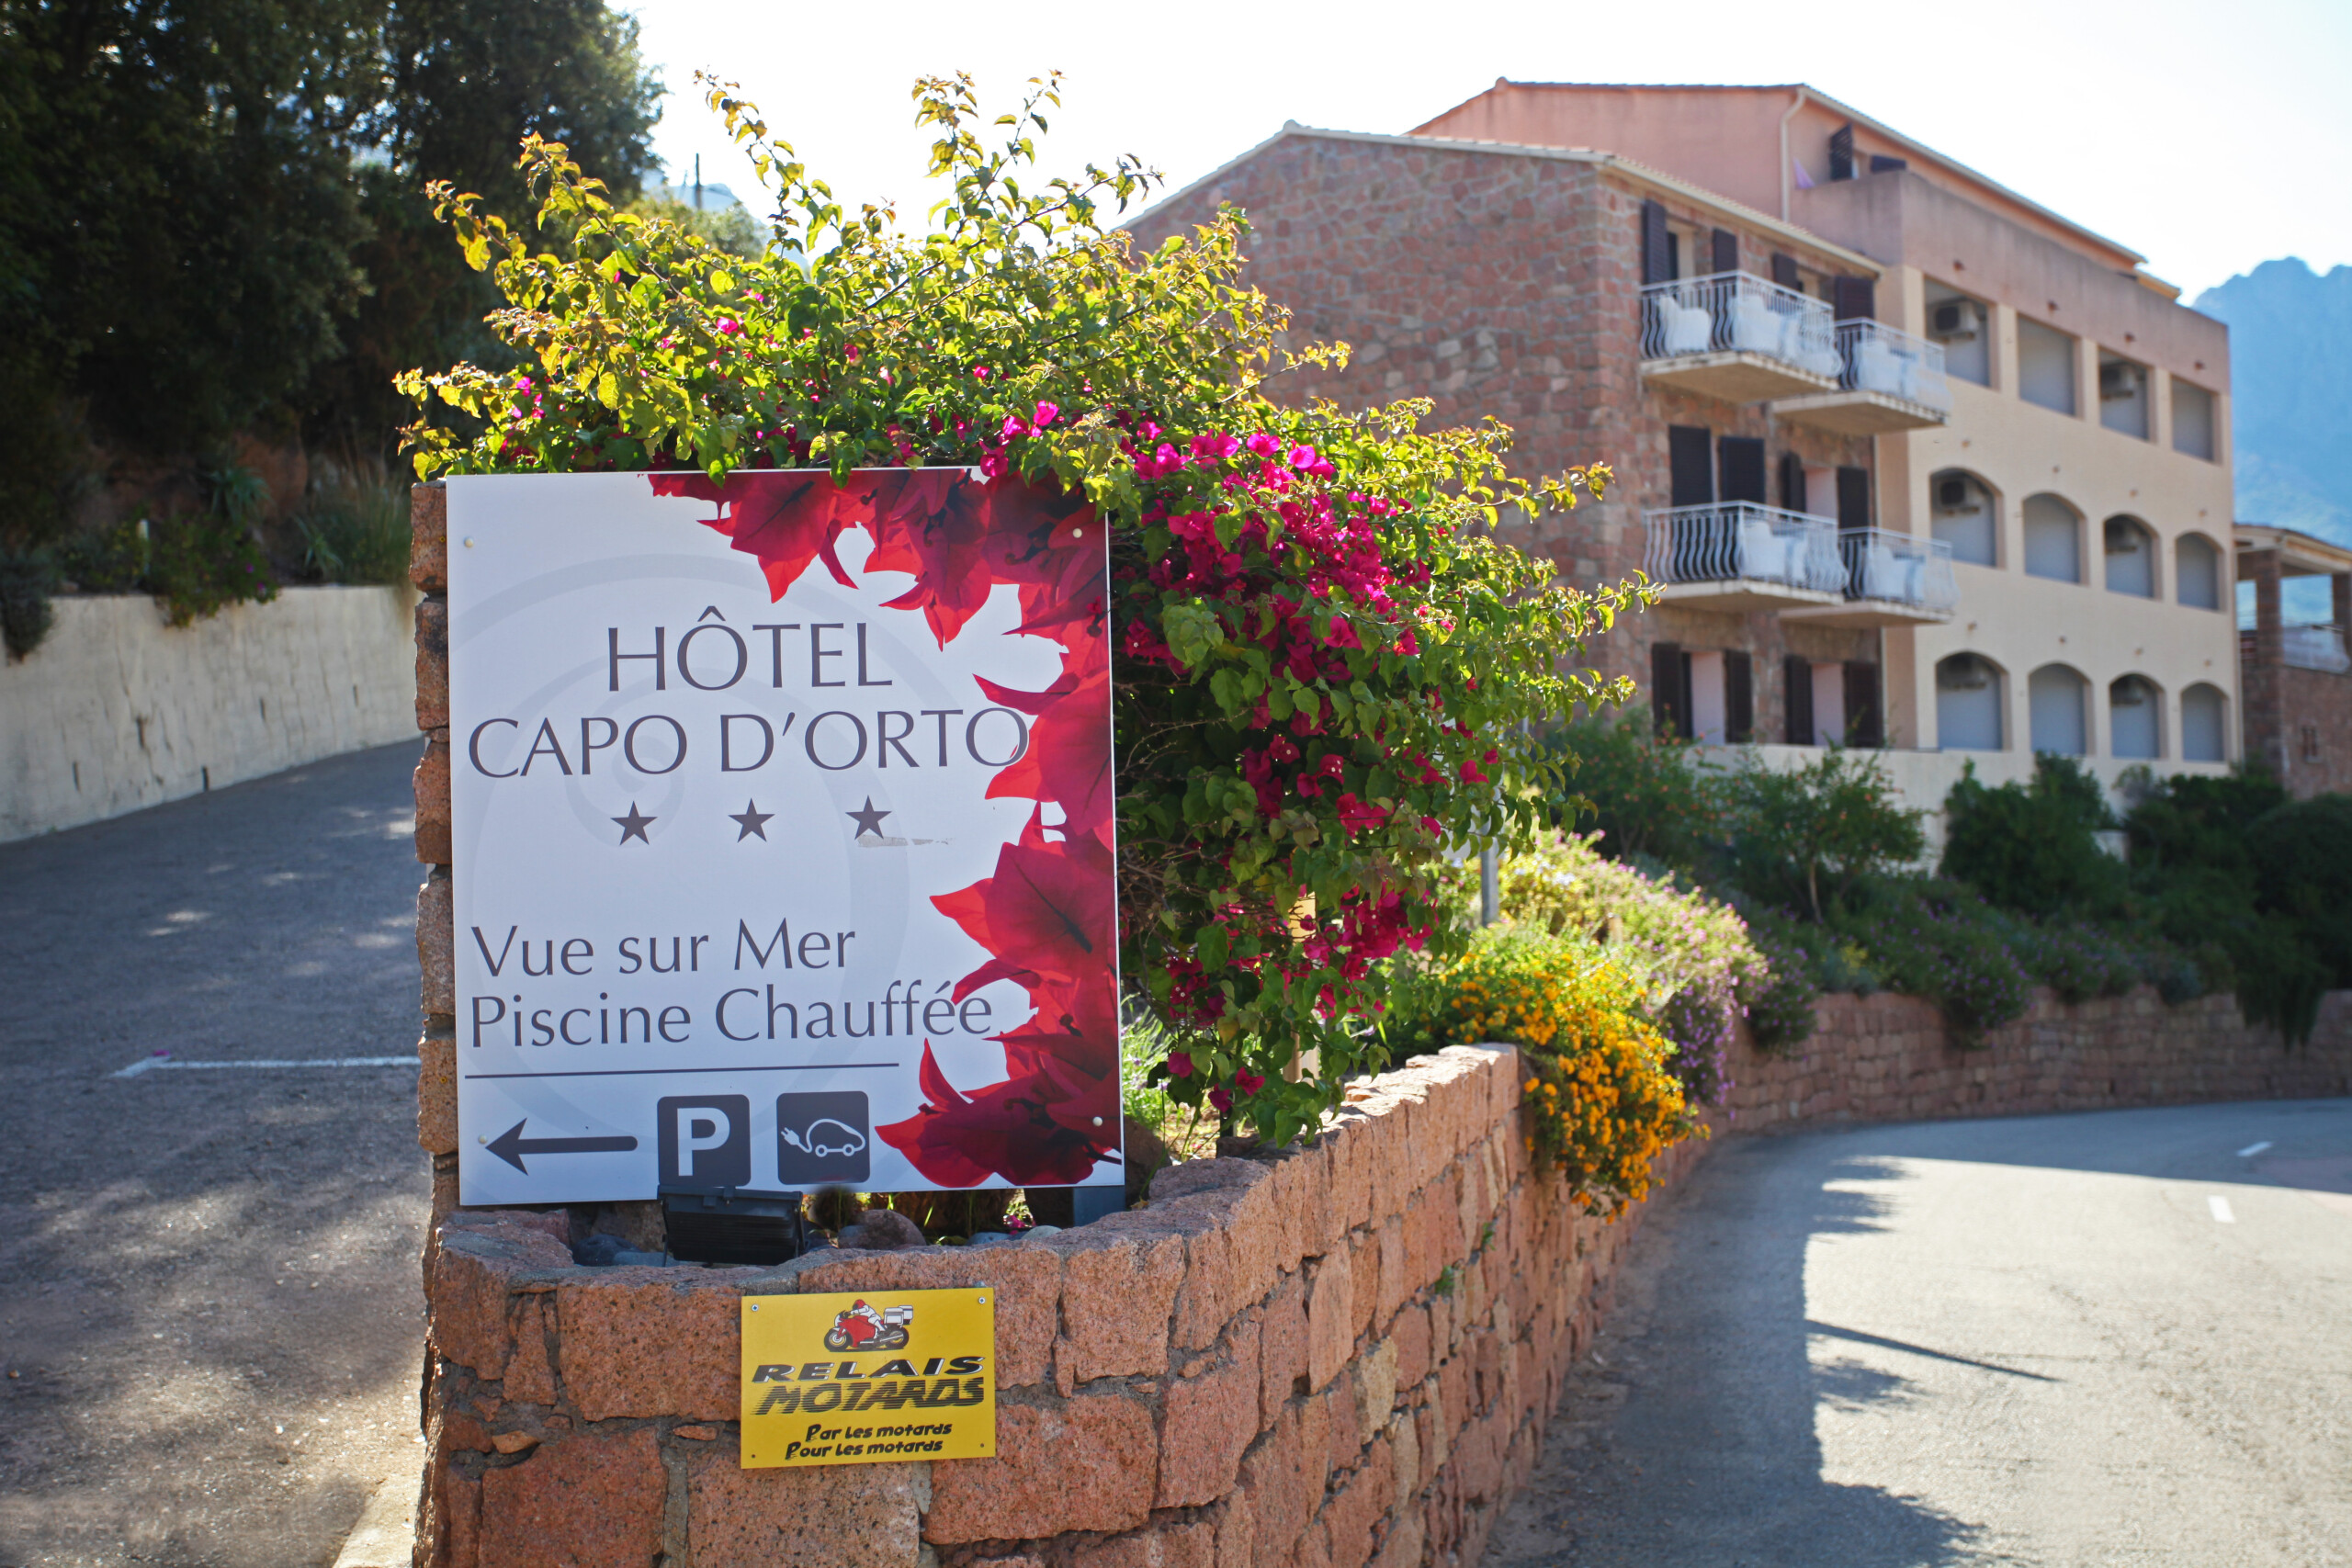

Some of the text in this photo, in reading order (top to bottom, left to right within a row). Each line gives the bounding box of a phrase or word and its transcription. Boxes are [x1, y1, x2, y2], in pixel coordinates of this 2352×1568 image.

[607, 605, 893, 692] HÔTEL
[468, 714, 688, 778] CAPO
[470, 917, 856, 977] Vue sur Mer
[471, 979, 992, 1048] Piscine Chauffée
[752, 1356, 986, 1383] RELAIS
[750, 1377, 985, 1416] MOTARDS
[785, 1441, 832, 1461] Pour
[866, 1439, 944, 1455] motards
[805, 1424, 841, 1443] Par
[876, 1423, 953, 1438] motards
